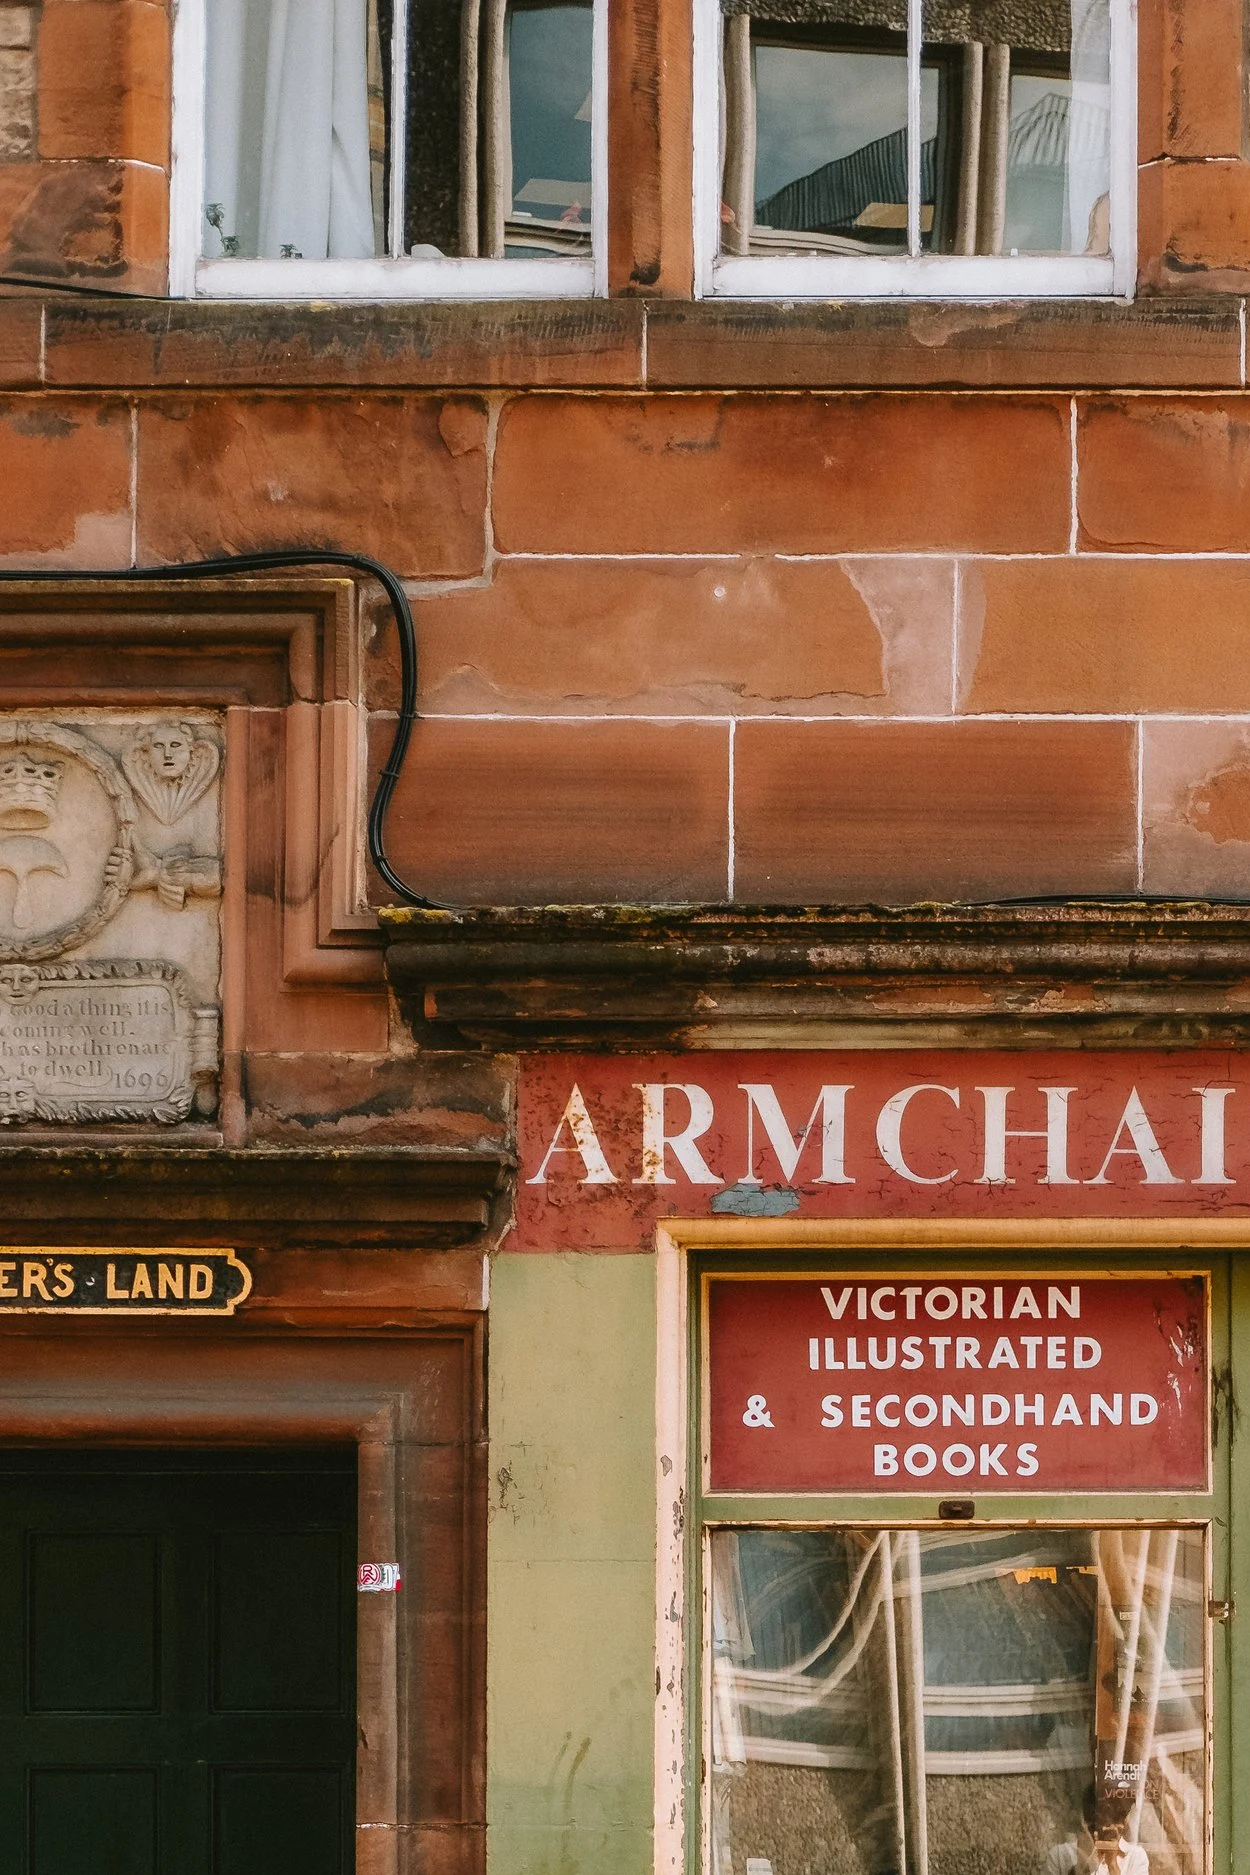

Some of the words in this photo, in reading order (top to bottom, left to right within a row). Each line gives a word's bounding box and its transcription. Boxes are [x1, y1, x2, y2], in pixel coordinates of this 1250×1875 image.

[114, 1066, 169, 1091] 1696
[106, 1263, 214, 1300] LAND
[819, 1286, 1081, 1321] VICTORIAN
[808, 1336, 1102, 1370] ILLUSTRATED
[741, 1394, 775, 1428] &
[820, 1393, 1159, 1428] SECONDHAND
[873, 1443, 1041, 1477] BOOKS
[1104, 1760, 1147, 1771] Hannah
[1104, 1770, 1141, 1781] Arendt
[1104, 1789, 1160, 1799] VIOLECE
